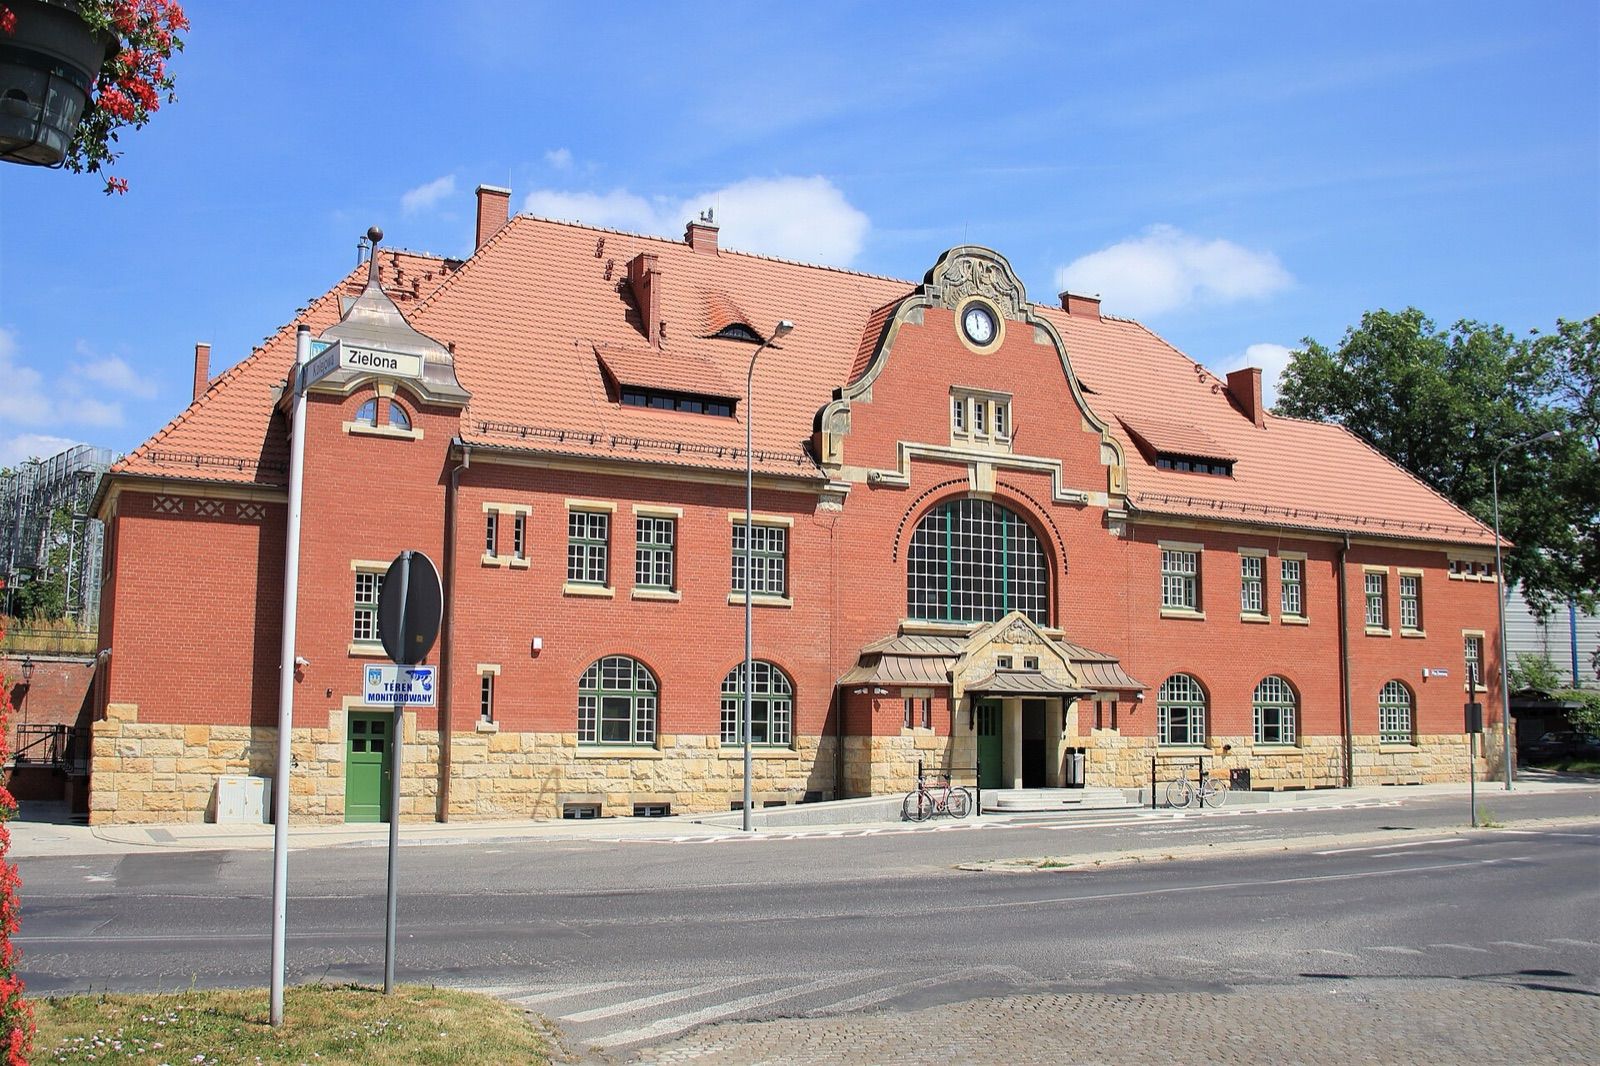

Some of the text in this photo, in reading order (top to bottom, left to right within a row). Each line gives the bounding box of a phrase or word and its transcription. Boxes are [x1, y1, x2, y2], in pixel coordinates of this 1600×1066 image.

[349, 350, 398, 369] Zielona
[384, 683, 413, 692] TEREN
[368, 693, 432, 702] MONITOROWANY
